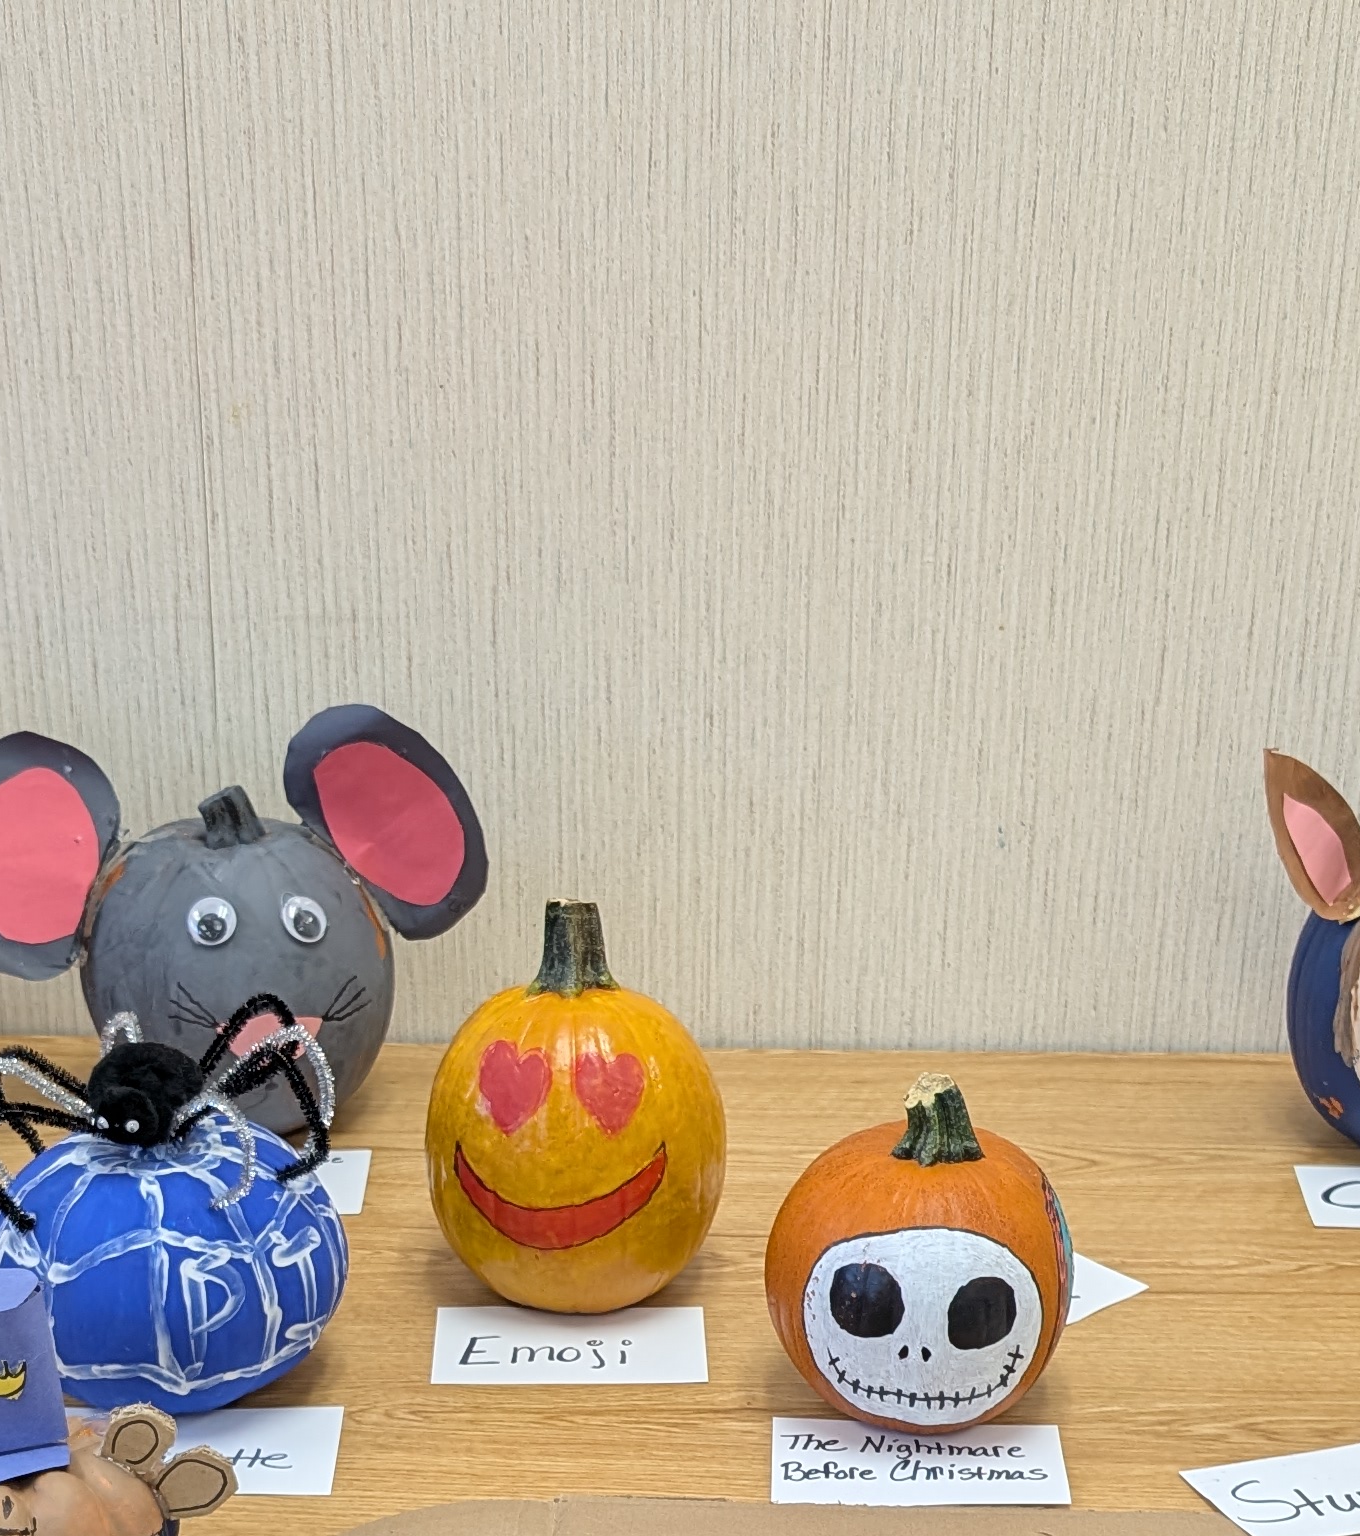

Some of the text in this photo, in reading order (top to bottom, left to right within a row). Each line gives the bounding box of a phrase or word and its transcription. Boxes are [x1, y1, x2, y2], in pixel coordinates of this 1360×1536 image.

[458, 1336, 633, 1369] Emoji
[780, 1433, 1026, 1461] The Nightmare
[780, 1459, 1049, 1482] Before Christmas
